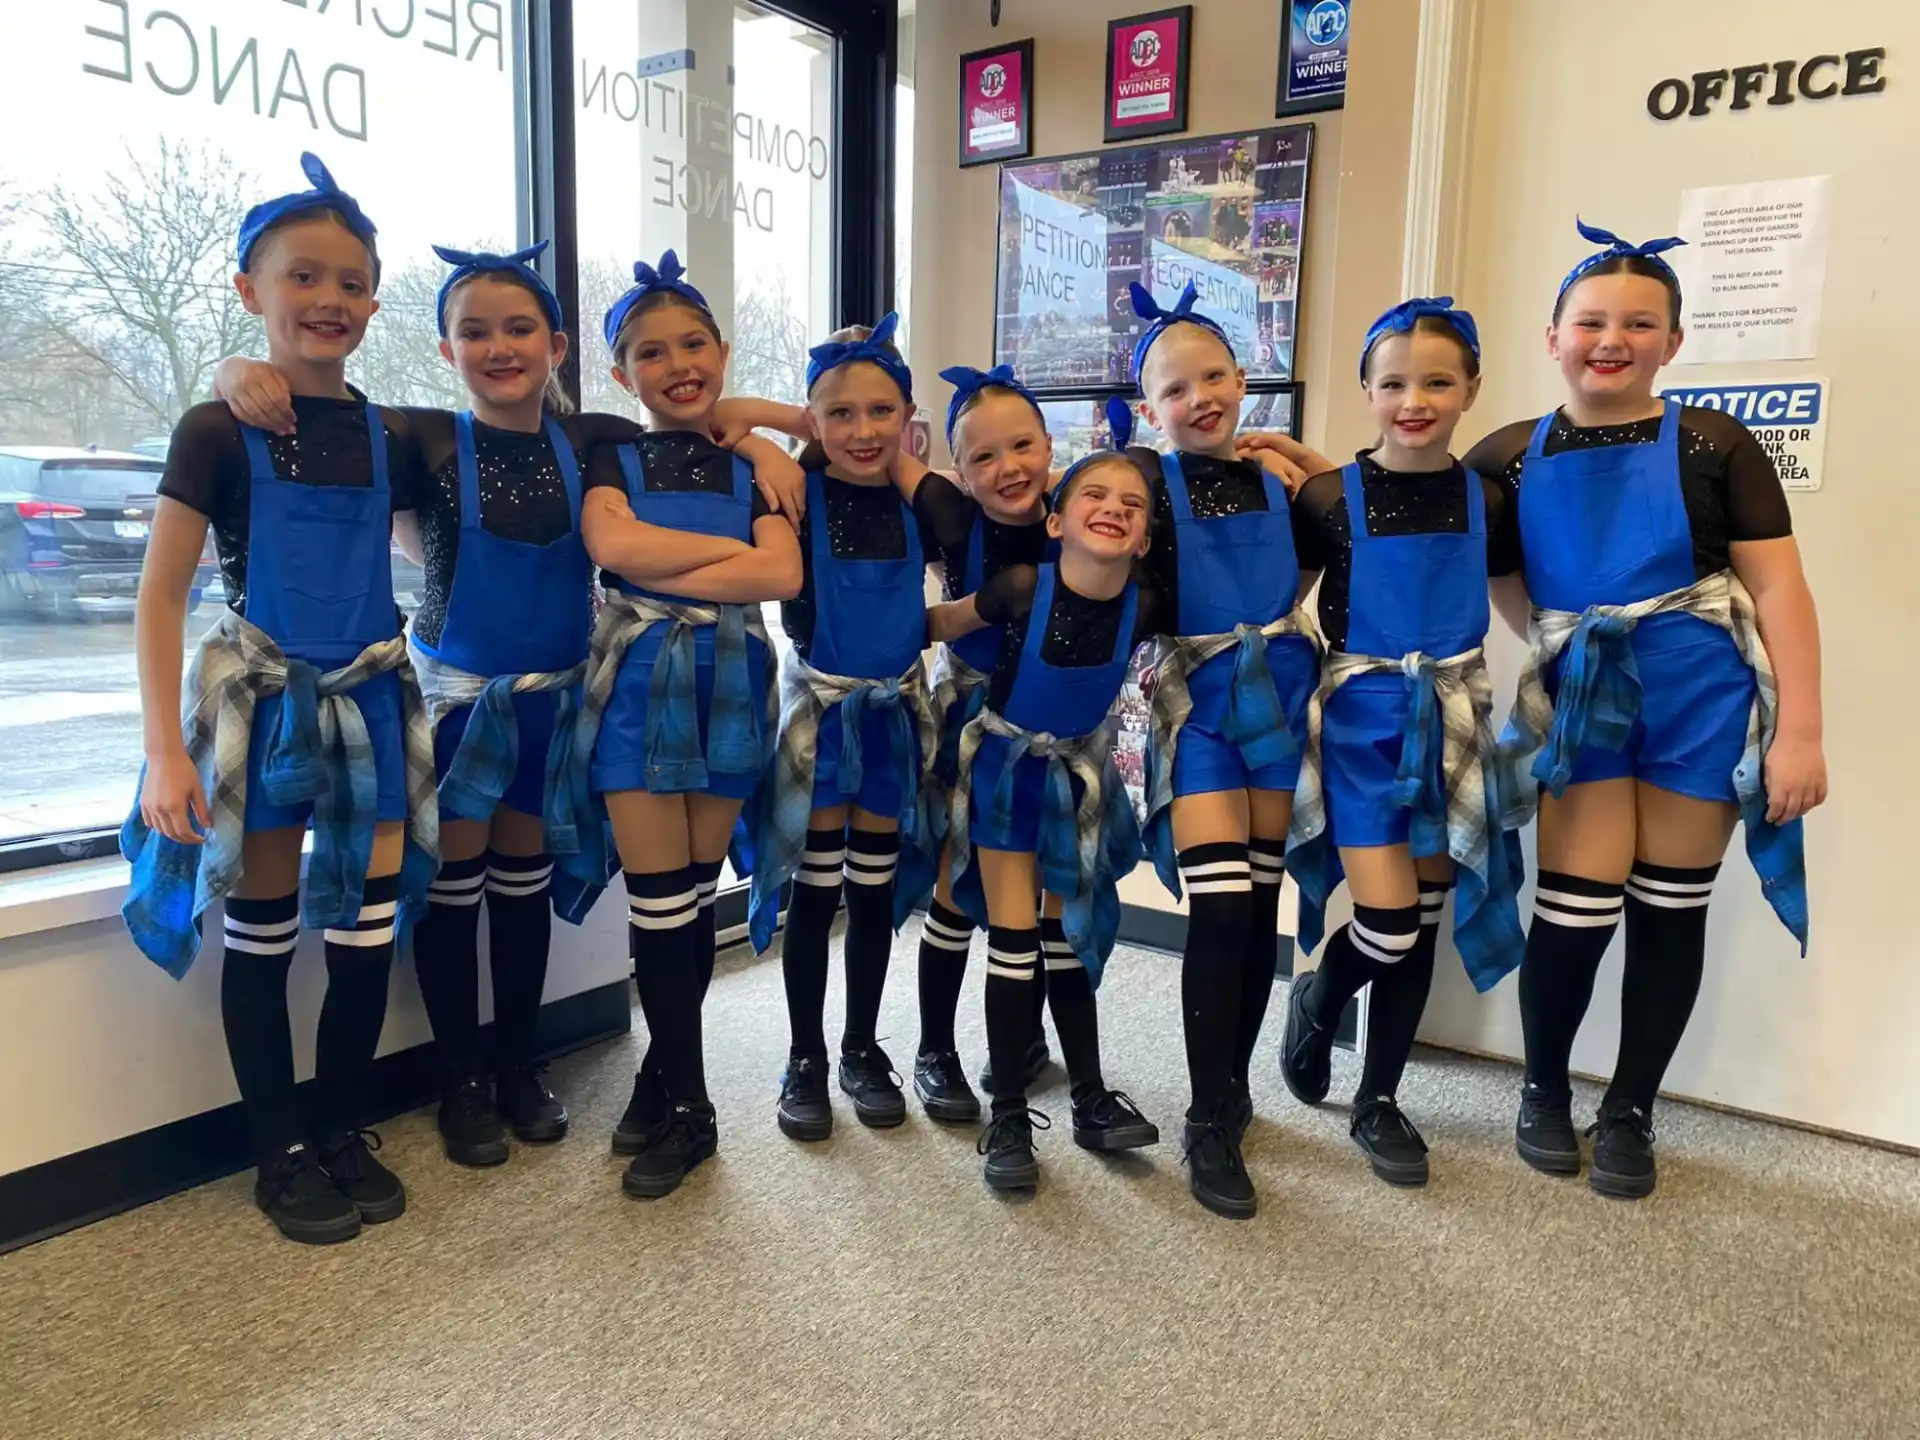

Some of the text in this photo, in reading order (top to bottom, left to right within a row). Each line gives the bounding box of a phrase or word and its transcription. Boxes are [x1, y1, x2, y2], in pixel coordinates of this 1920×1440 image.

[1119, 78, 1170, 97] WINNER
[1647, 47, 1887, 121] OFFICE
[971, 106, 1016, 121] WINNER
[1755, 204, 1775, 213] AREA
[1786, 201, 1803, 209] OUR
[1703, 219, 1728, 227] STUDIO
[1737, 214, 1773, 224] INTENDED
[1774, 213, 1788, 221] FOR
[1789, 211, 1802, 219] THE
[1022, 212, 1106, 273] PETITION
[1700, 237, 1736, 248] WARMING
[1748, 234, 1760, 243] OR
[1724, 246, 1744, 256] THEIR
[1712, 272, 1727, 280] THIS
[1735, 270, 1751, 278] NOT
[1751, 269, 1763, 277] AN
[1764, 268, 1783, 276] AREA
[1722, 284, 1737, 292] RUN
[1738, 282, 1769, 291] AROUND
[1692, 305, 1798, 320] THANK YOU FOR RESPECTING
[1693, 323, 1706, 331] THE
[1708, 321, 1731, 330] RULES
[1743, 319, 1760, 328] OUR
[1789, 428, 1810, 441] OR
[1777, 467, 1810, 480] REA
